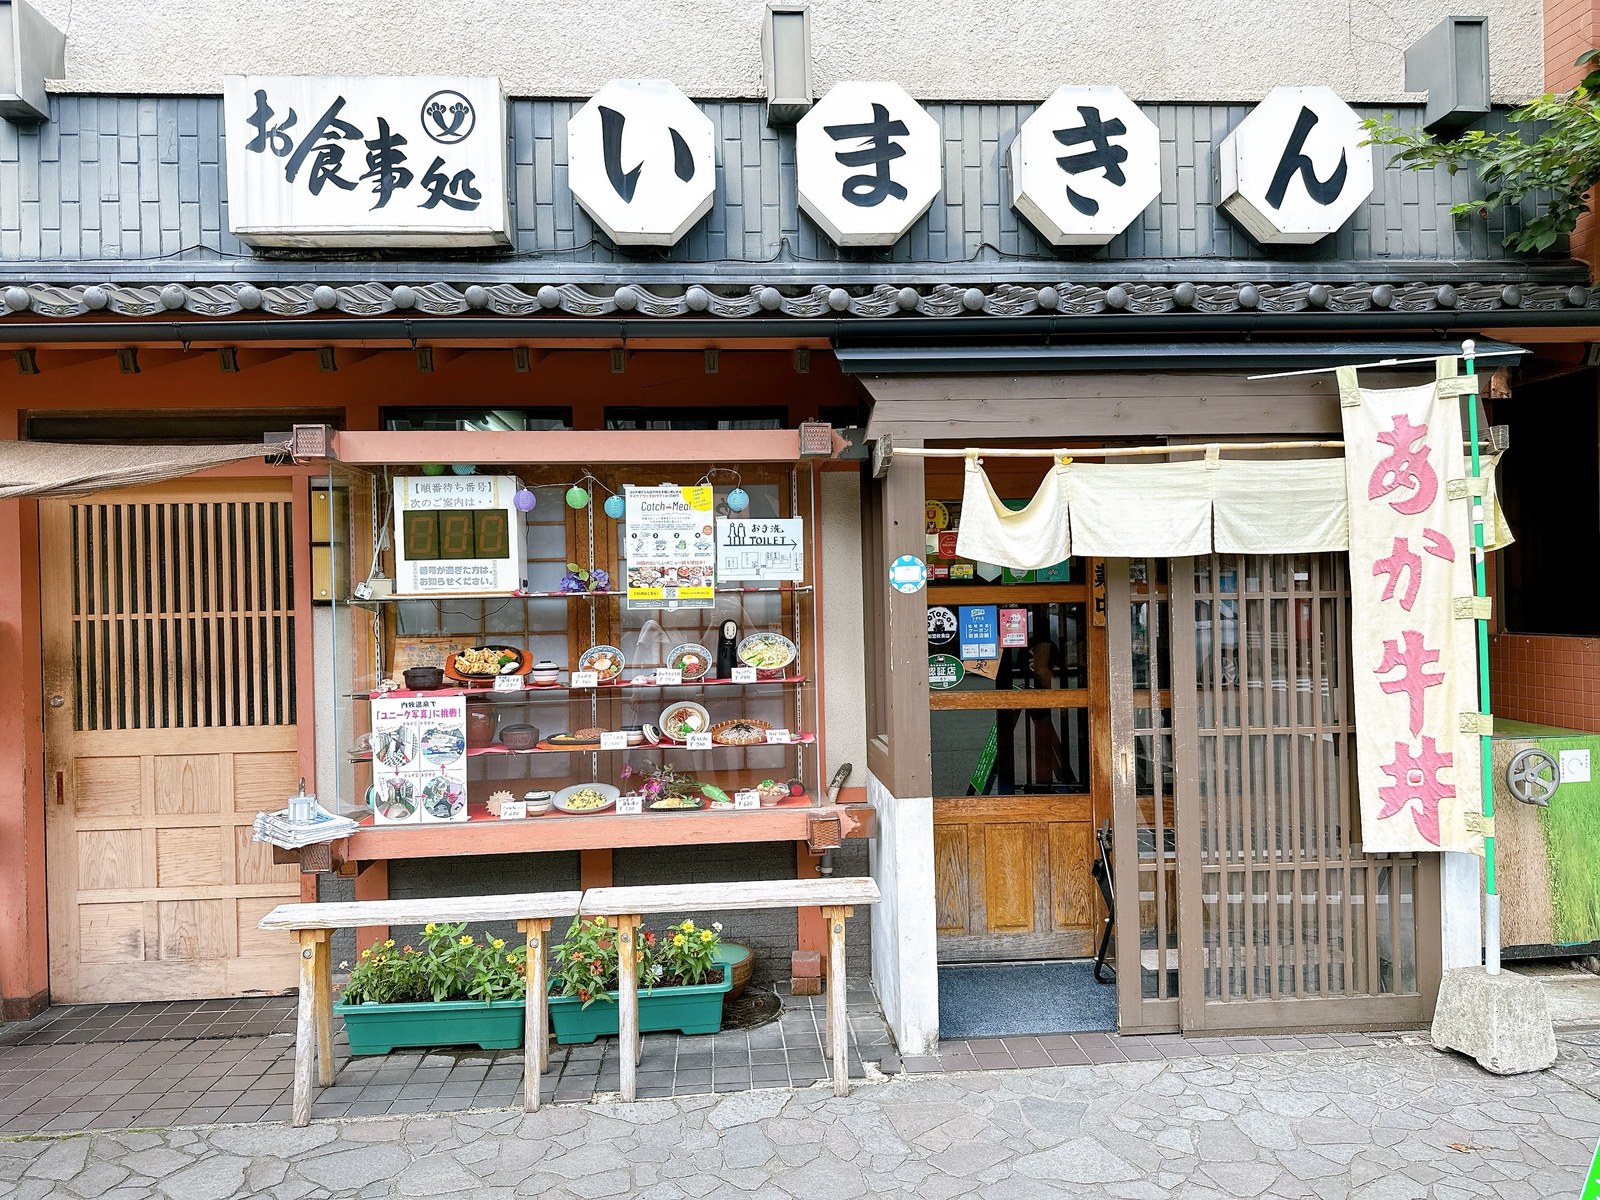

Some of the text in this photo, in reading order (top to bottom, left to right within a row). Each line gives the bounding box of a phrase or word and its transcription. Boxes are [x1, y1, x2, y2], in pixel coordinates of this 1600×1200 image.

[245, 88, 482, 212] お食事処
[641, 501, 665, 511] Catch
[749, 536, 787, 545] TOILET
[420, 577, 493, 586] お知らせください。
[1367, 412, 1456, 848] あか牛丼
